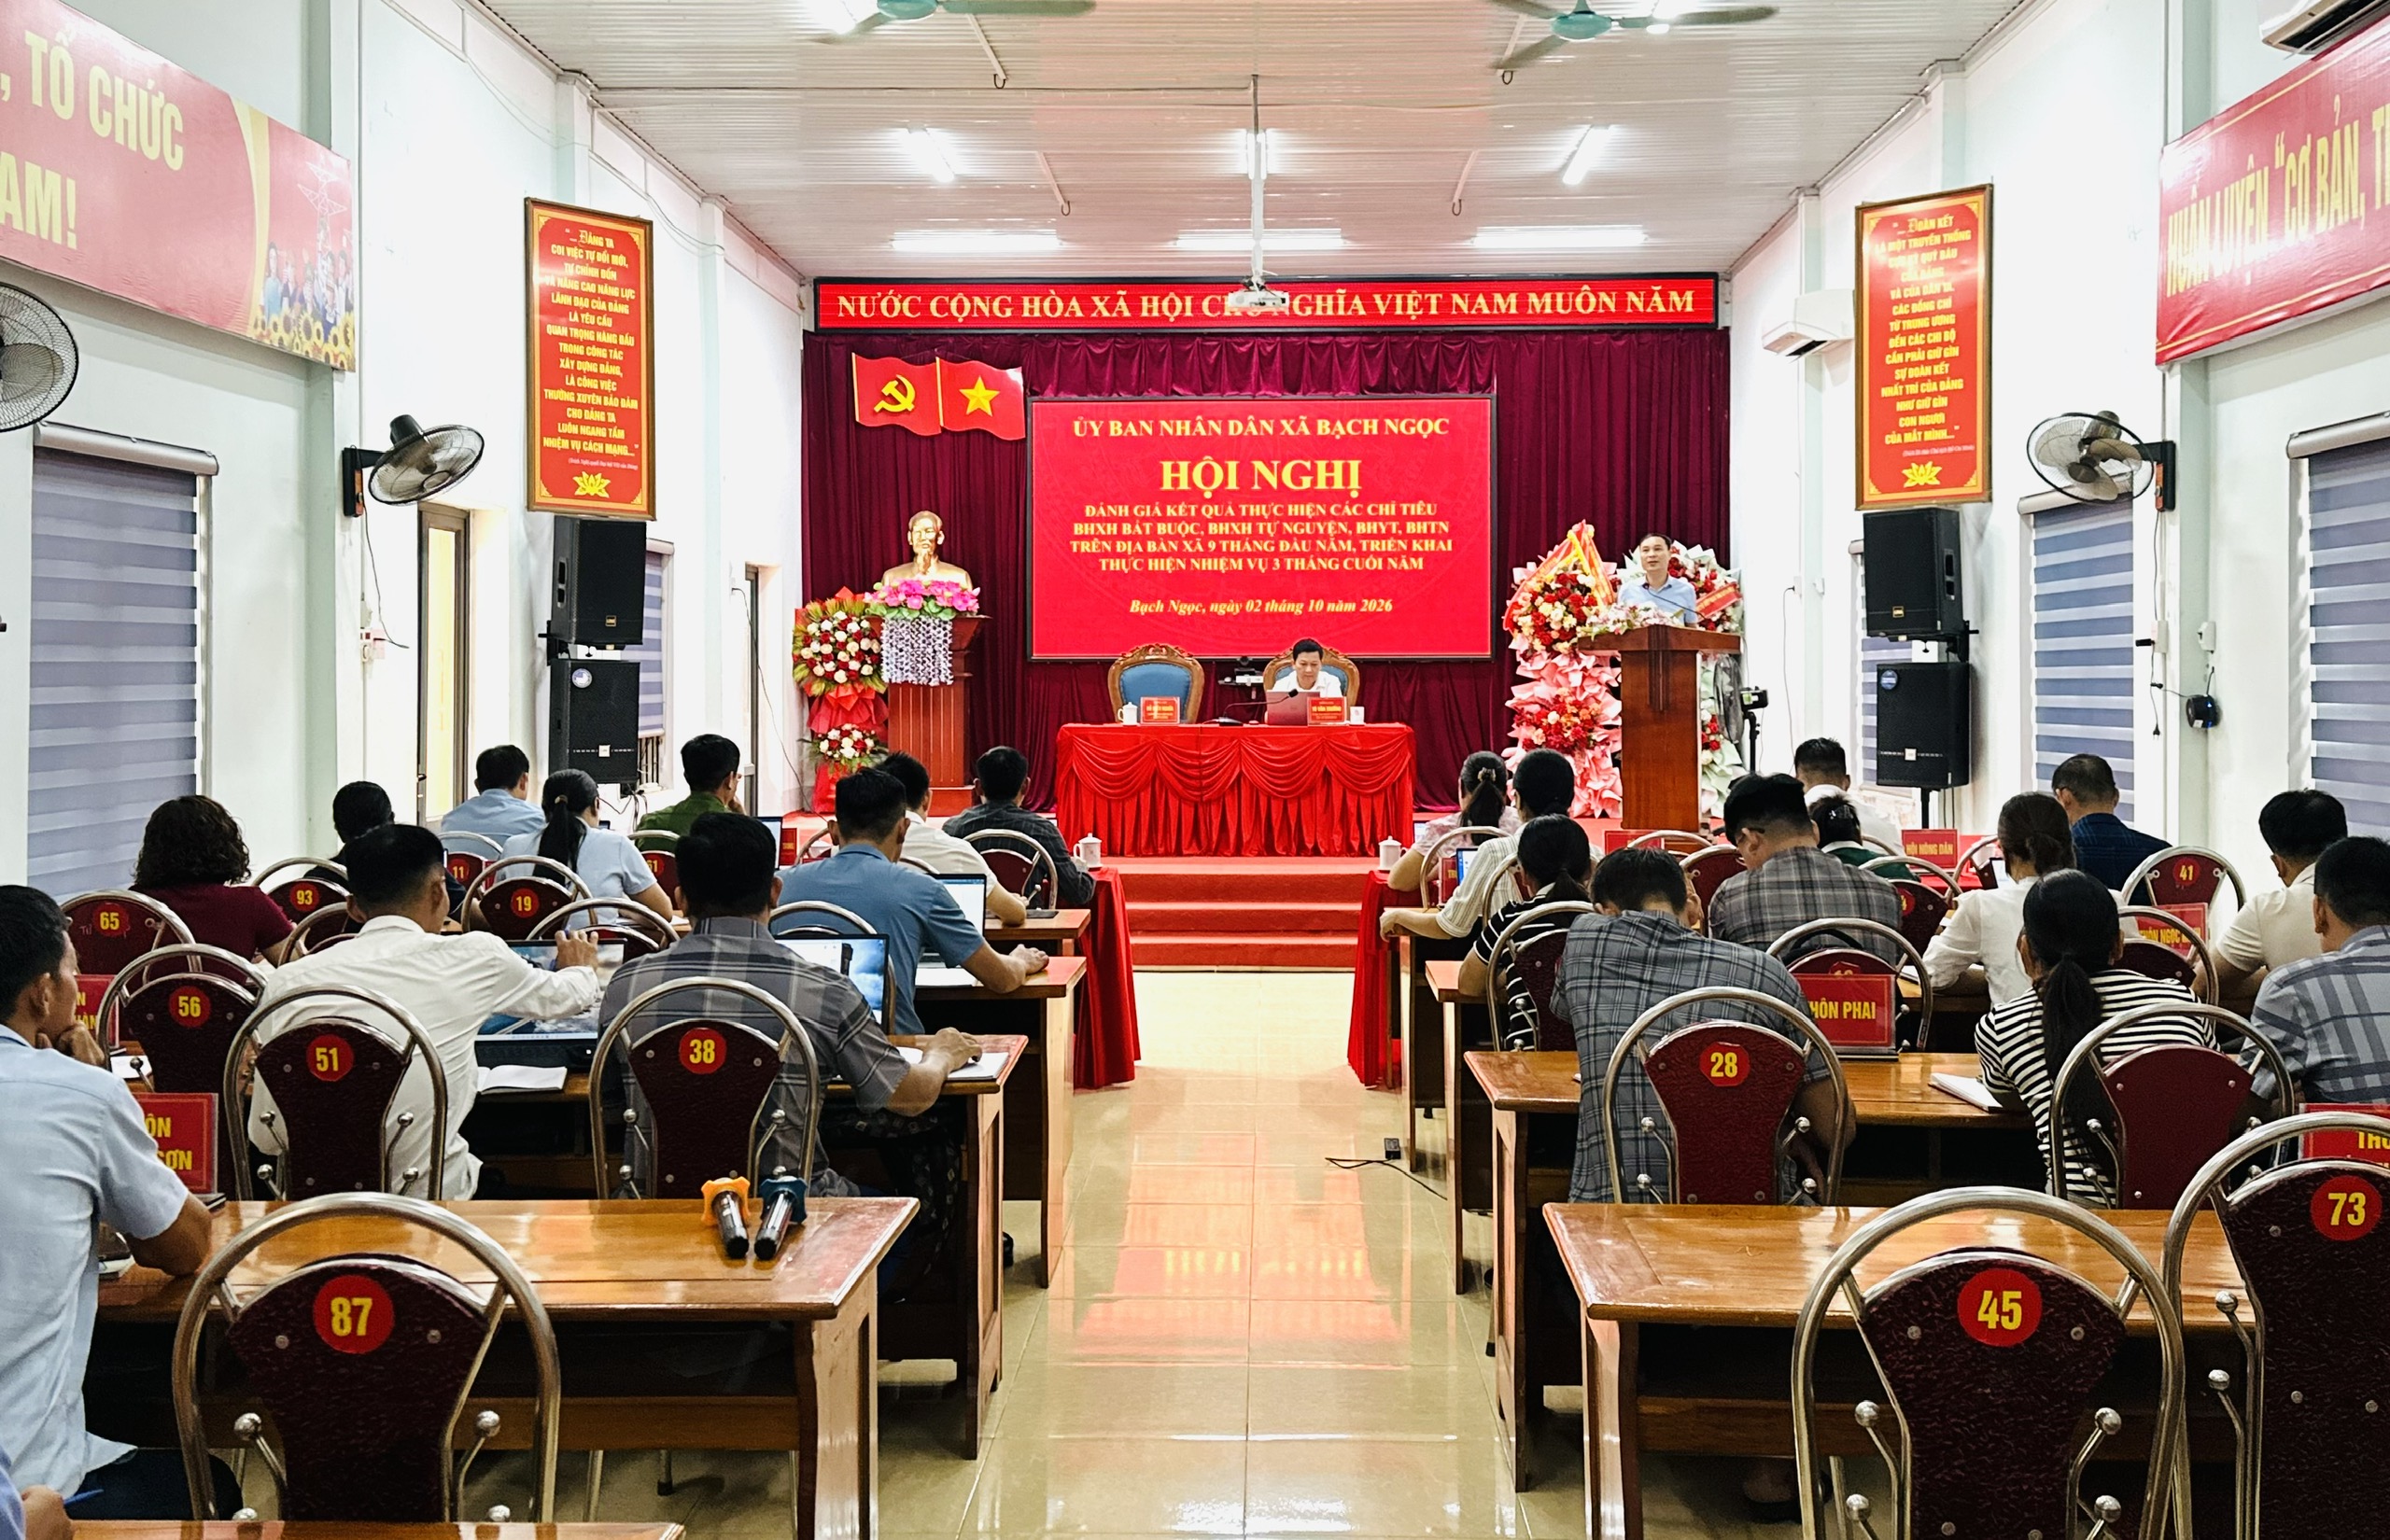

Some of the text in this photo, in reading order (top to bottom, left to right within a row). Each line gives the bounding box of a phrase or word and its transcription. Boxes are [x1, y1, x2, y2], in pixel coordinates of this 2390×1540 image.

[25, 29, 184, 171] TỔ CHỨC
[2316, 94, 2365, 230] BẢN,
[837, 290, 921, 318] NƯỚC
[929, 292, 1014, 323] CỘNG
[1022, 289, 1083, 318] HÒA
[1090, 290, 1131, 317] XÃ
[1140, 292, 1193, 322] HỘI
[1272, 289, 1366, 316] GHĨA
[1375, 290, 1442, 321] VIỆT
[1451, 292, 1519, 315] NAM
[1526, 286, 1617, 315] MUÔN
[1625, 286, 1694, 313] NĂM
[1074, 415, 1449, 439] ỦY BAN NHÂN DÂN XÃ BẠCH NGỌC
[1160, 456, 1362, 498] HỘI NGHỊ
[1085, 500, 1437, 519] ĐÁNH GIÁ KẾT QUẢ THỰC HIỆN CÁC CHỈ TIÊU
[1074, 520, 1449, 537] BHXH BẮT BUỘC, BHXH TỰ NGUYỆN, BHYT, BHTN
[1070, 537, 1452, 554] TRÊN ĐỊA BÀN XÃ 9 THÁNG ĐẦU NĂM, TRIỂN KHAI
[1100, 555, 1424, 573] THỰC HIỆN NHIỆM VỤ 3 THÁNG CUỐI NĂM
[1130, 599, 1393, 614] Bạch Ngọc, ngày 02 tháng 10 năm 2026
[453, 865, 465, 879] 11
[2179, 864, 2194, 880] 41
[296, 889, 314, 905] 93
[515, 895, 532, 912] 19
[100, 911, 120, 931] 65
[177, 996, 202, 1017] 56
[1809, 997, 1877, 1019] HÔN PHAI
[316, 1047, 340, 1072] 51
[689, 1039, 715, 1064] 38
[1710, 1051, 1738, 1078] 28
[145, 1113, 172, 1138] ÔN
[2327, 1193, 2366, 1226] 73
[330, 1296, 373, 1337] 87
[1976, 1290, 2023, 1330] 45
